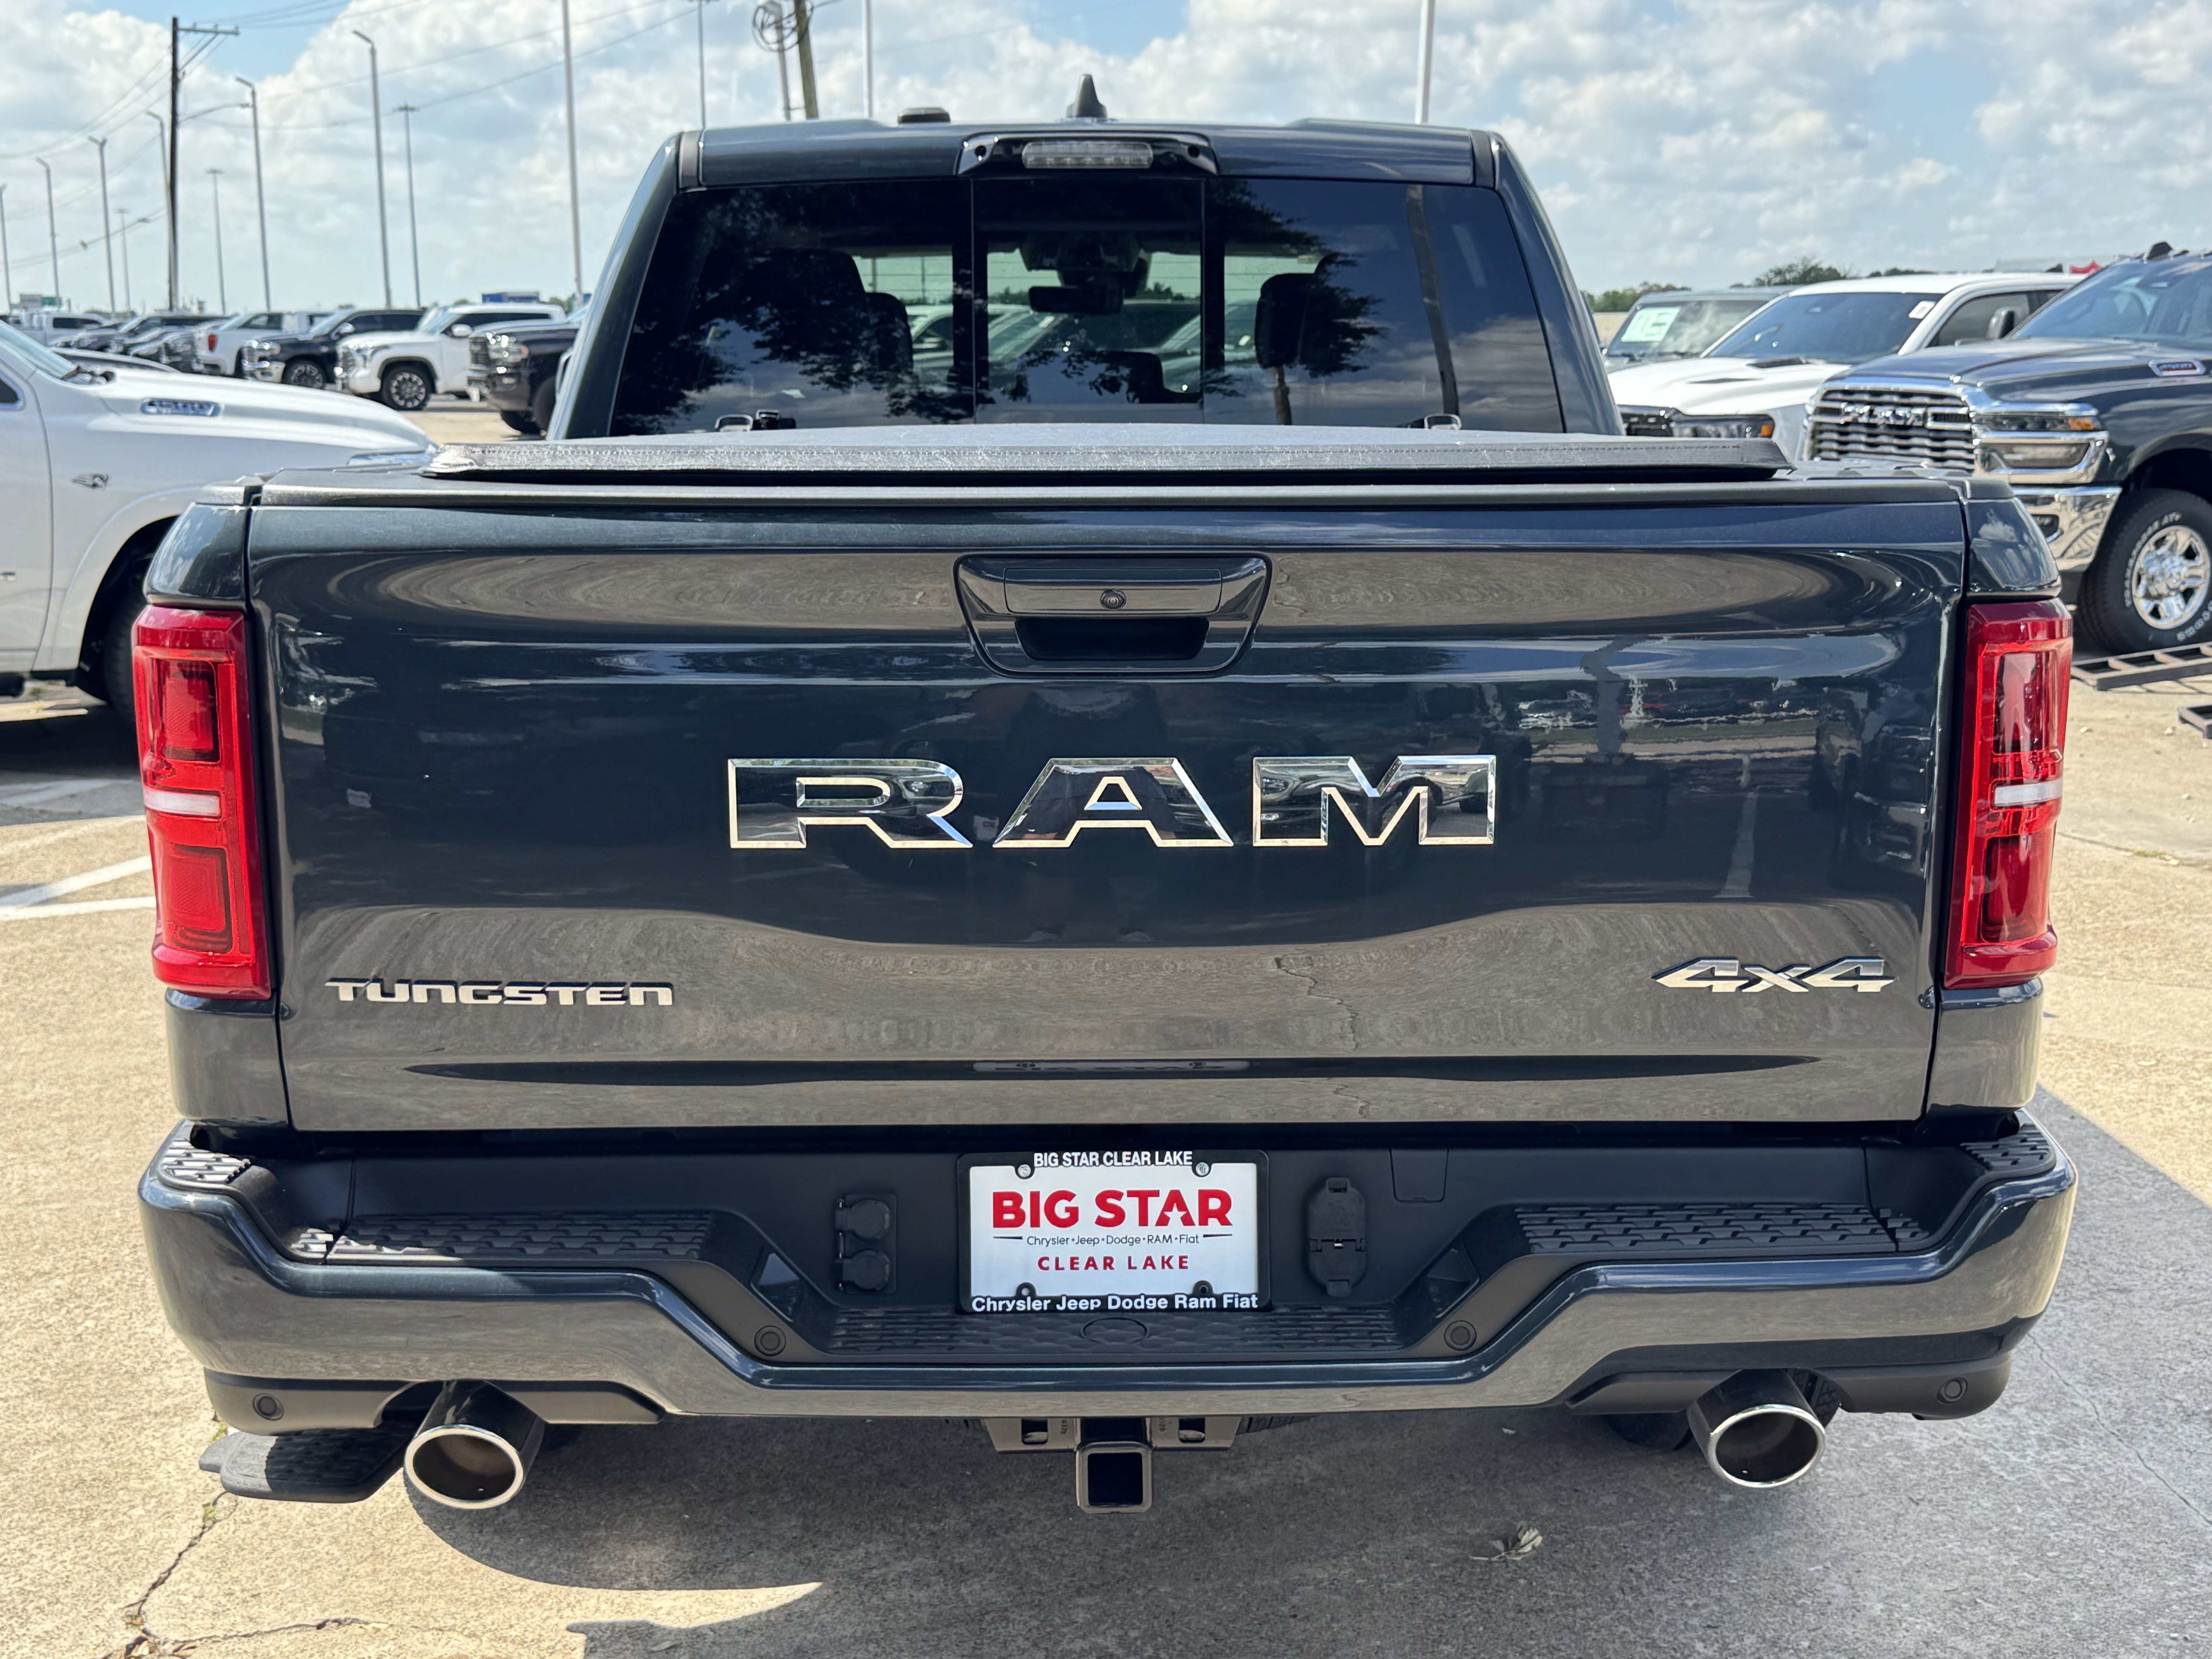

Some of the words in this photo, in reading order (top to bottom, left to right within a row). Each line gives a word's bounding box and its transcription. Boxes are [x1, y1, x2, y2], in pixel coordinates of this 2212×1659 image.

[728, 756, 1496, 849] RAM
[325, 978, 674, 1006] TUNGSTEN
[1034, 1152, 1058, 1167] BIG
[1062, 1152, 1099, 1167] STAR
[1103, 1152, 1151, 1166] CLEAR
[1155, 1151, 1192, 1166] LAKE
[993, 1190, 1079, 1228] BIG
[1095, 1189, 1233, 1228] STAR
[1027, 1236, 1070, 1247] Chrysler
[1075, 1236, 1100, 1247] Jeep
[1106, 1235, 1141, 1246] Dodge
[1147, 1234, 1173, 1243] RAM
[1179, 1234, 1199, 1243] Fiat
[1037, 1256, 1115, 1271] CLEAR
[1128, 1255, 1188, 1270] LAKE
[972, 1296, 1050, 1312] Chrysler
[1056, 1295, 1101, 1310] Jeep
[1108, 1294, 1168, 1309] Dodge
[1175, 1294, 1216, 1309] Ram
[1223, 1294, 1258, 1308] Fiat
